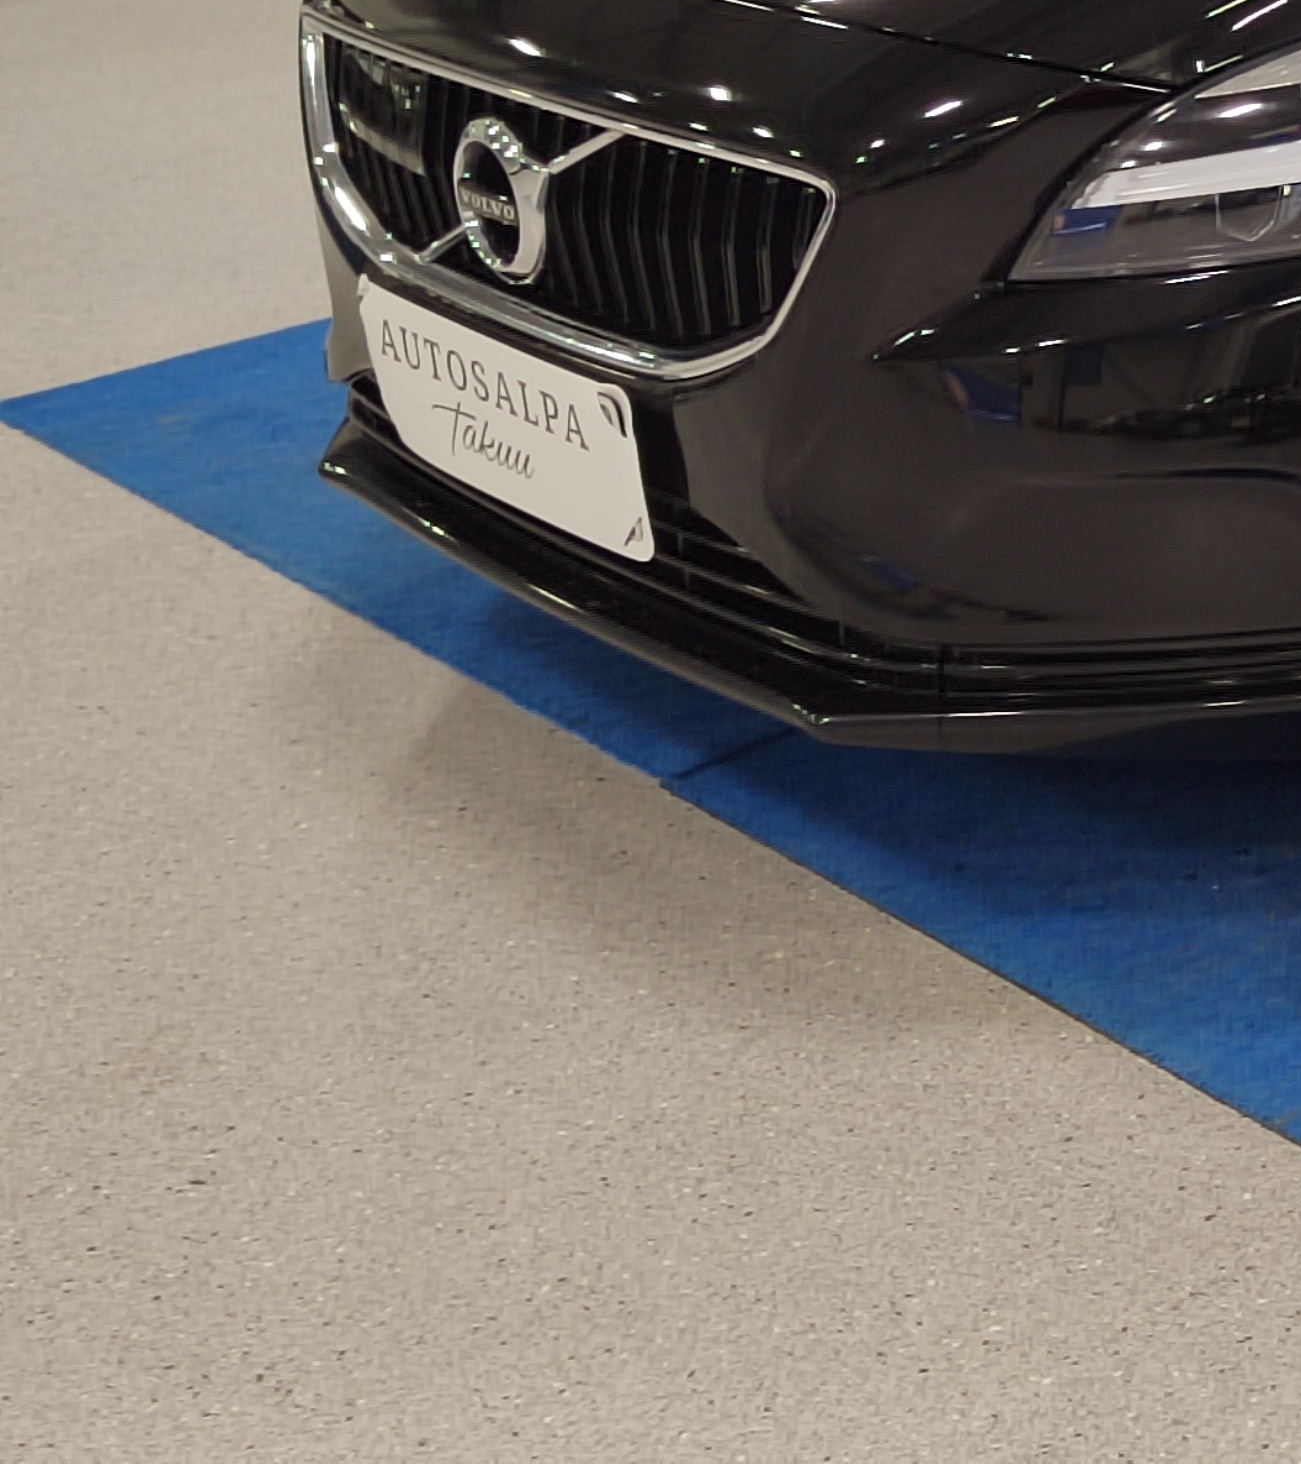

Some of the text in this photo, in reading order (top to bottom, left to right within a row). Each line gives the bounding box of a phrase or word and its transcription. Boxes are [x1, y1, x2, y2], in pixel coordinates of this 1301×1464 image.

[459, 185, 515, 220] VOLVO
[381, 319, 590, 452] AUTOSALPA
[432, 401, 535, 479] Takuu
